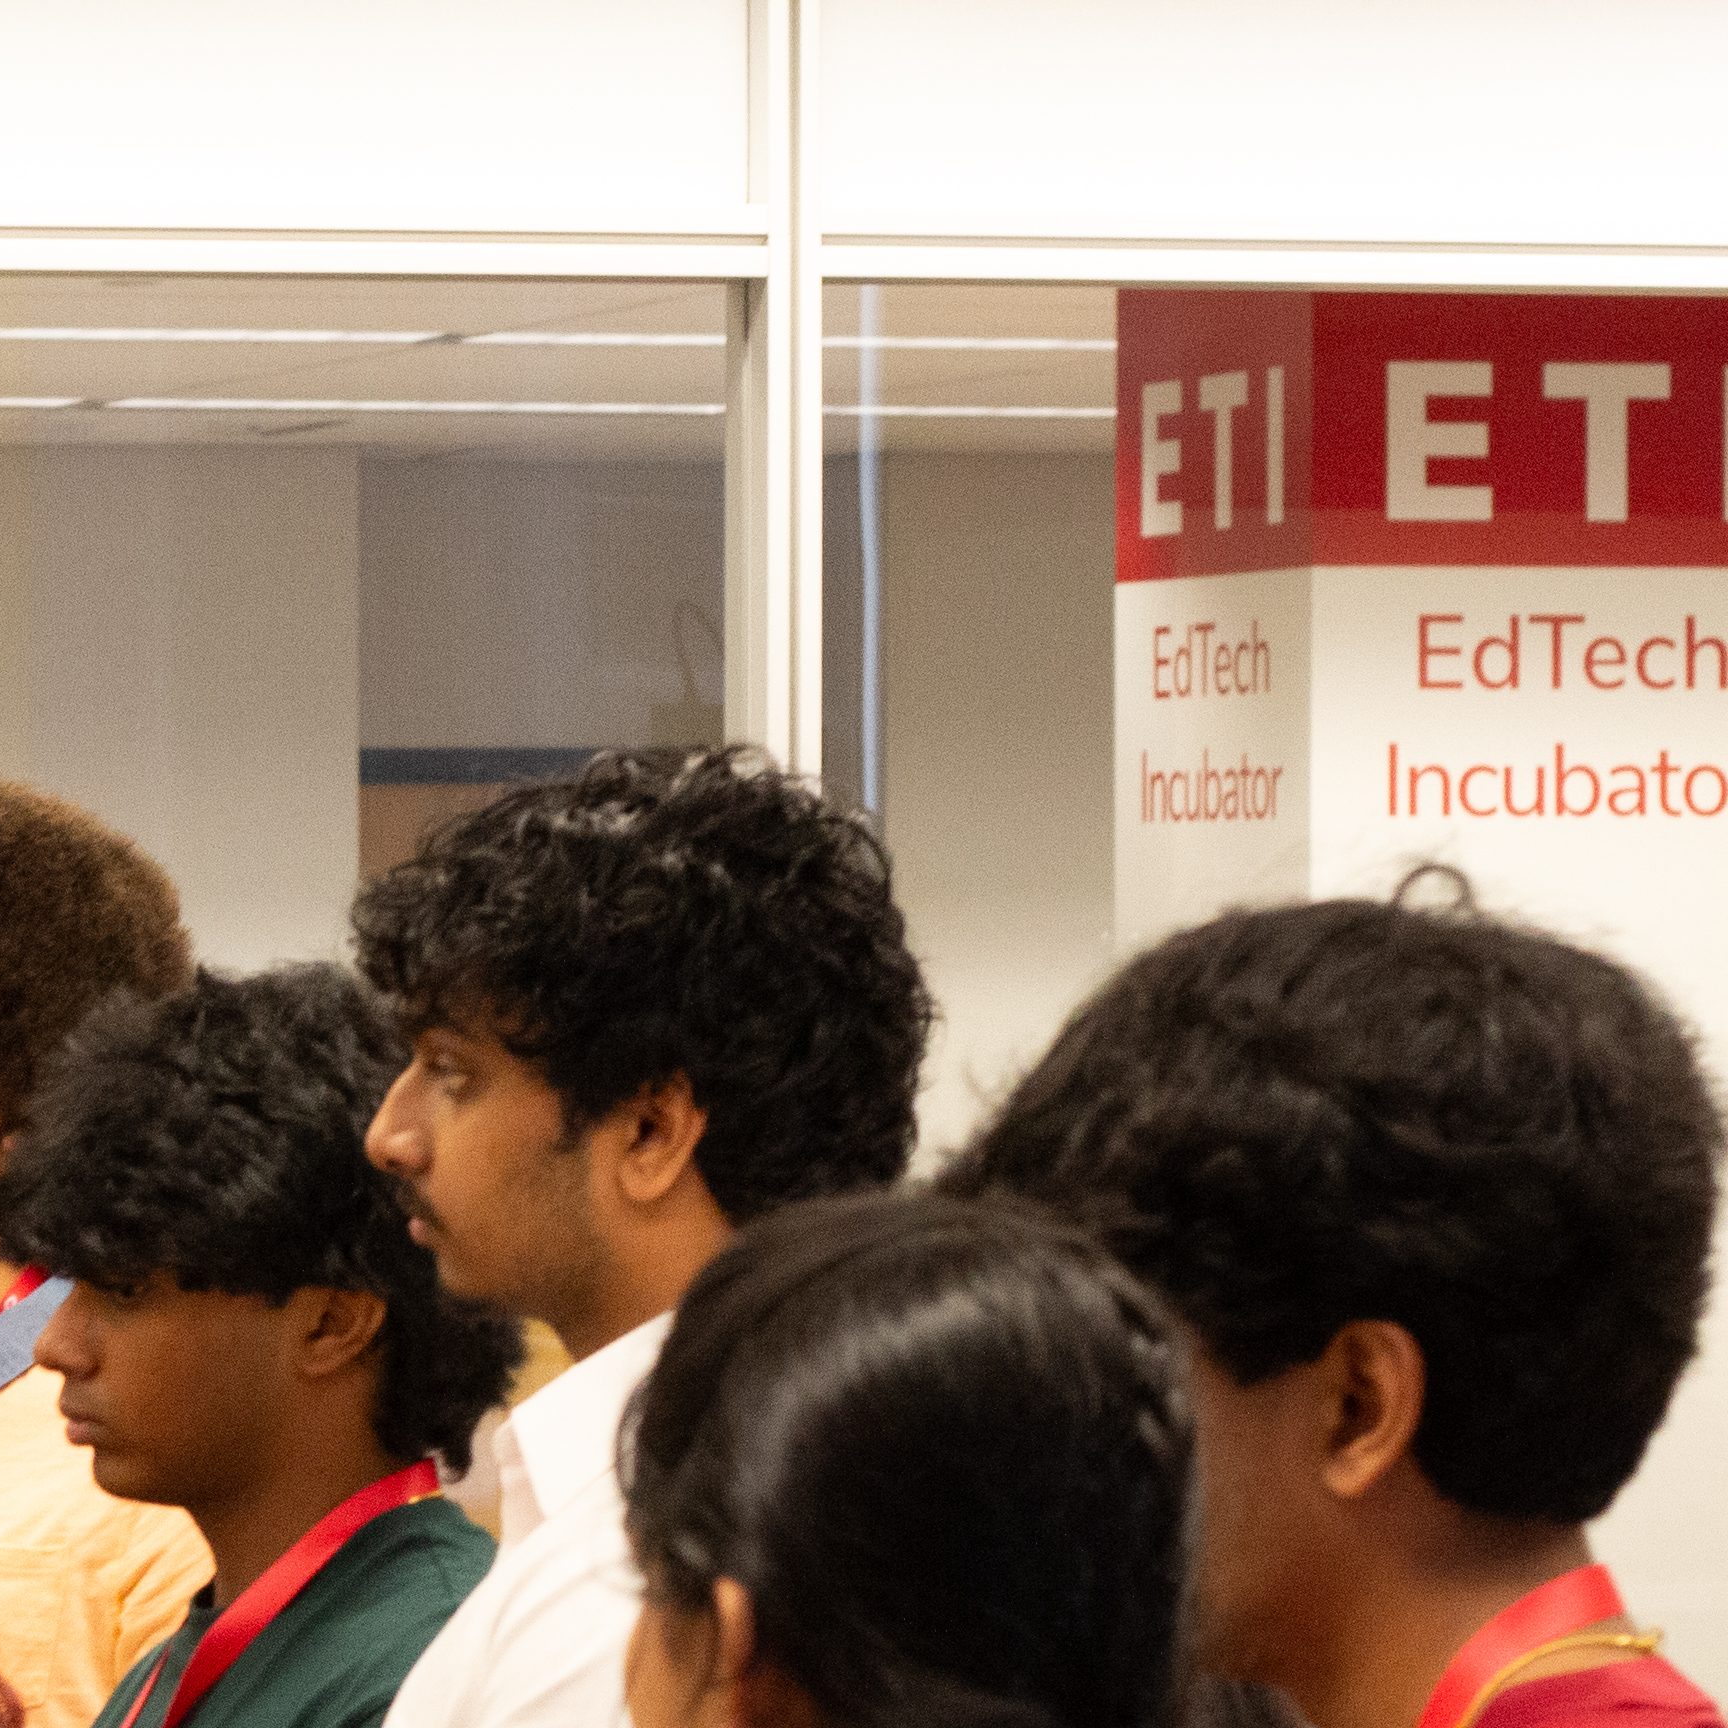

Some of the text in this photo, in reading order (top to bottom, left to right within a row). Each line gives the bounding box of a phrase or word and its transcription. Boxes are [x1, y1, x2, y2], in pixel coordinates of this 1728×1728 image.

[1141, 366, 1284, 538] ETI
[1385, 360, 1728, 523] ET
[1154, 620, 1271, 698] EdTech
[1418, 614, 1728, 690] EdTech
[1141, 748, 1282, 823] Incubator
[1388, 742, 1728, 818] Incubato
